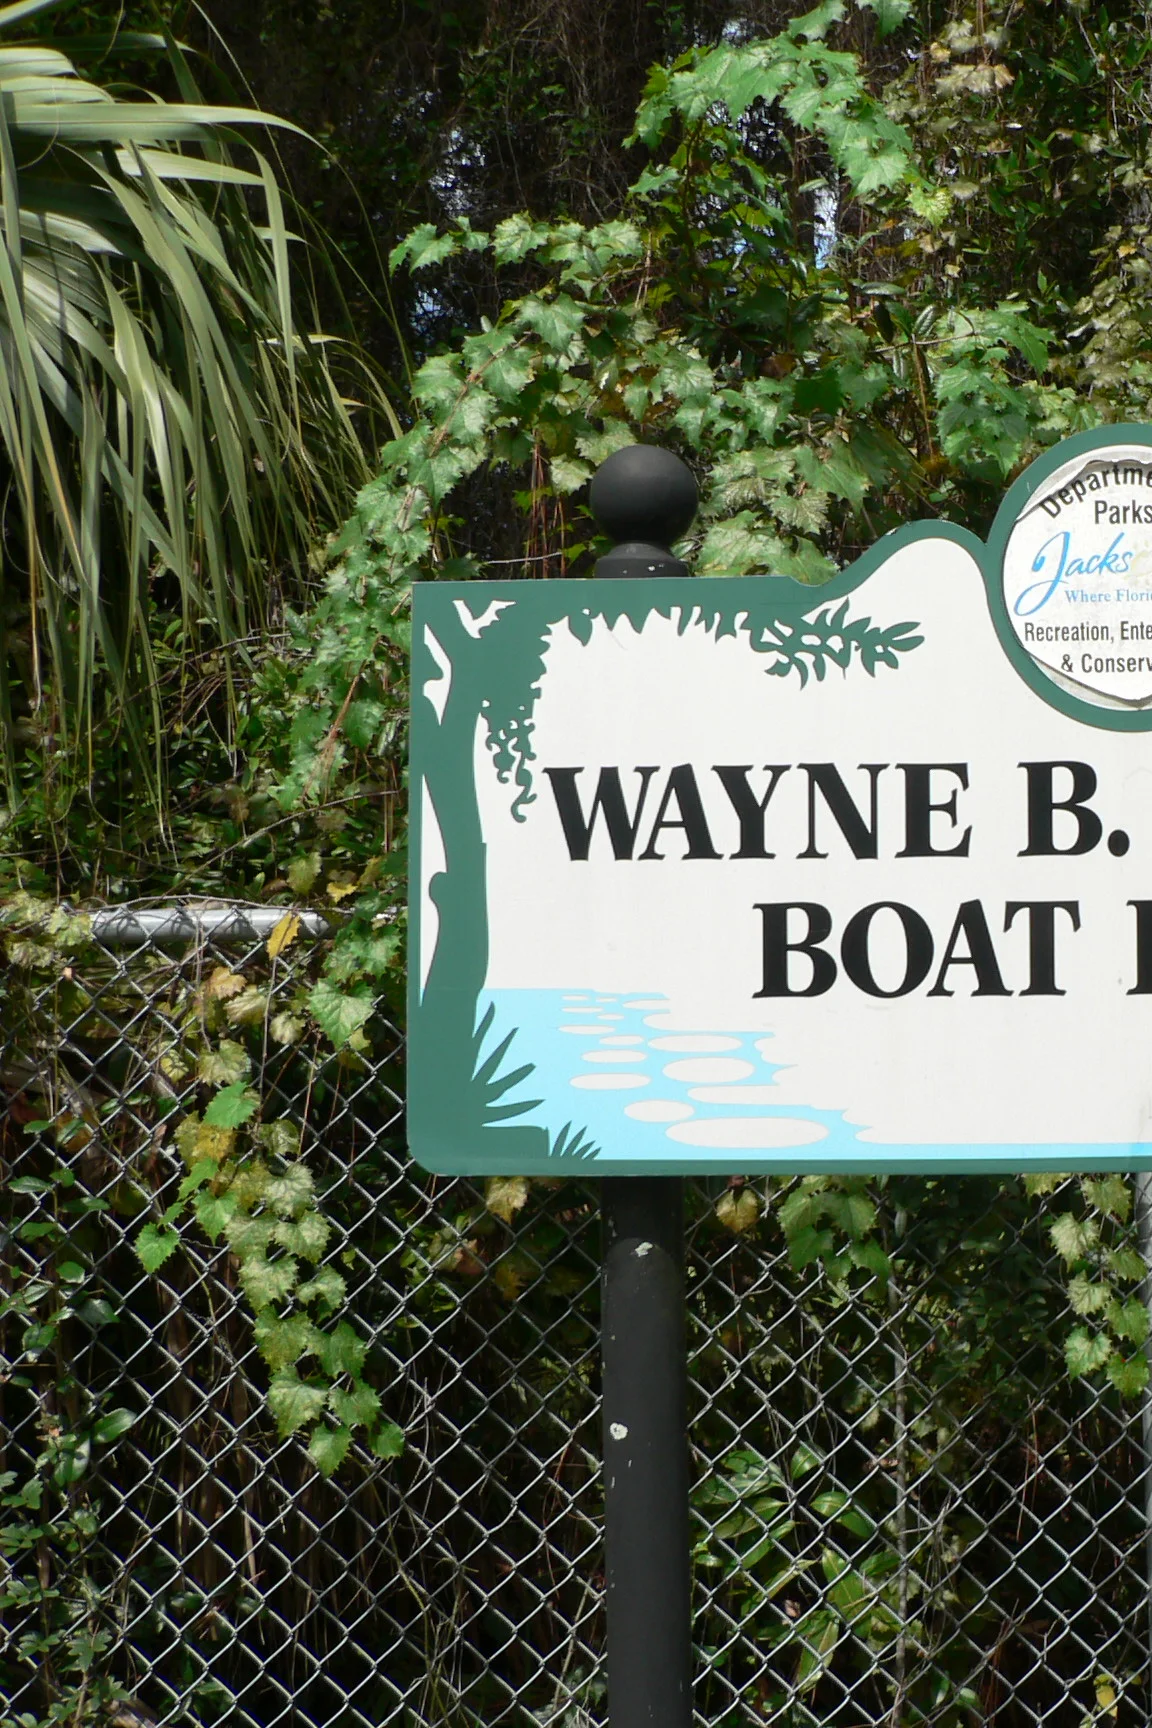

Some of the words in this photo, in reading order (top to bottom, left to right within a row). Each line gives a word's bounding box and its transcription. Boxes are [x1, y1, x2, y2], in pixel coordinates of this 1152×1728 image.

[1064, 589, 1111, 603] Where
[1024, 621, 1115, 644] Recreation,
[1060, 653, 1074, 673] &
[543, 763, 972, 860] WAYNE
[1018, 761, 1130, 857] B.
[752, 899, 1081, 998] BOAT
